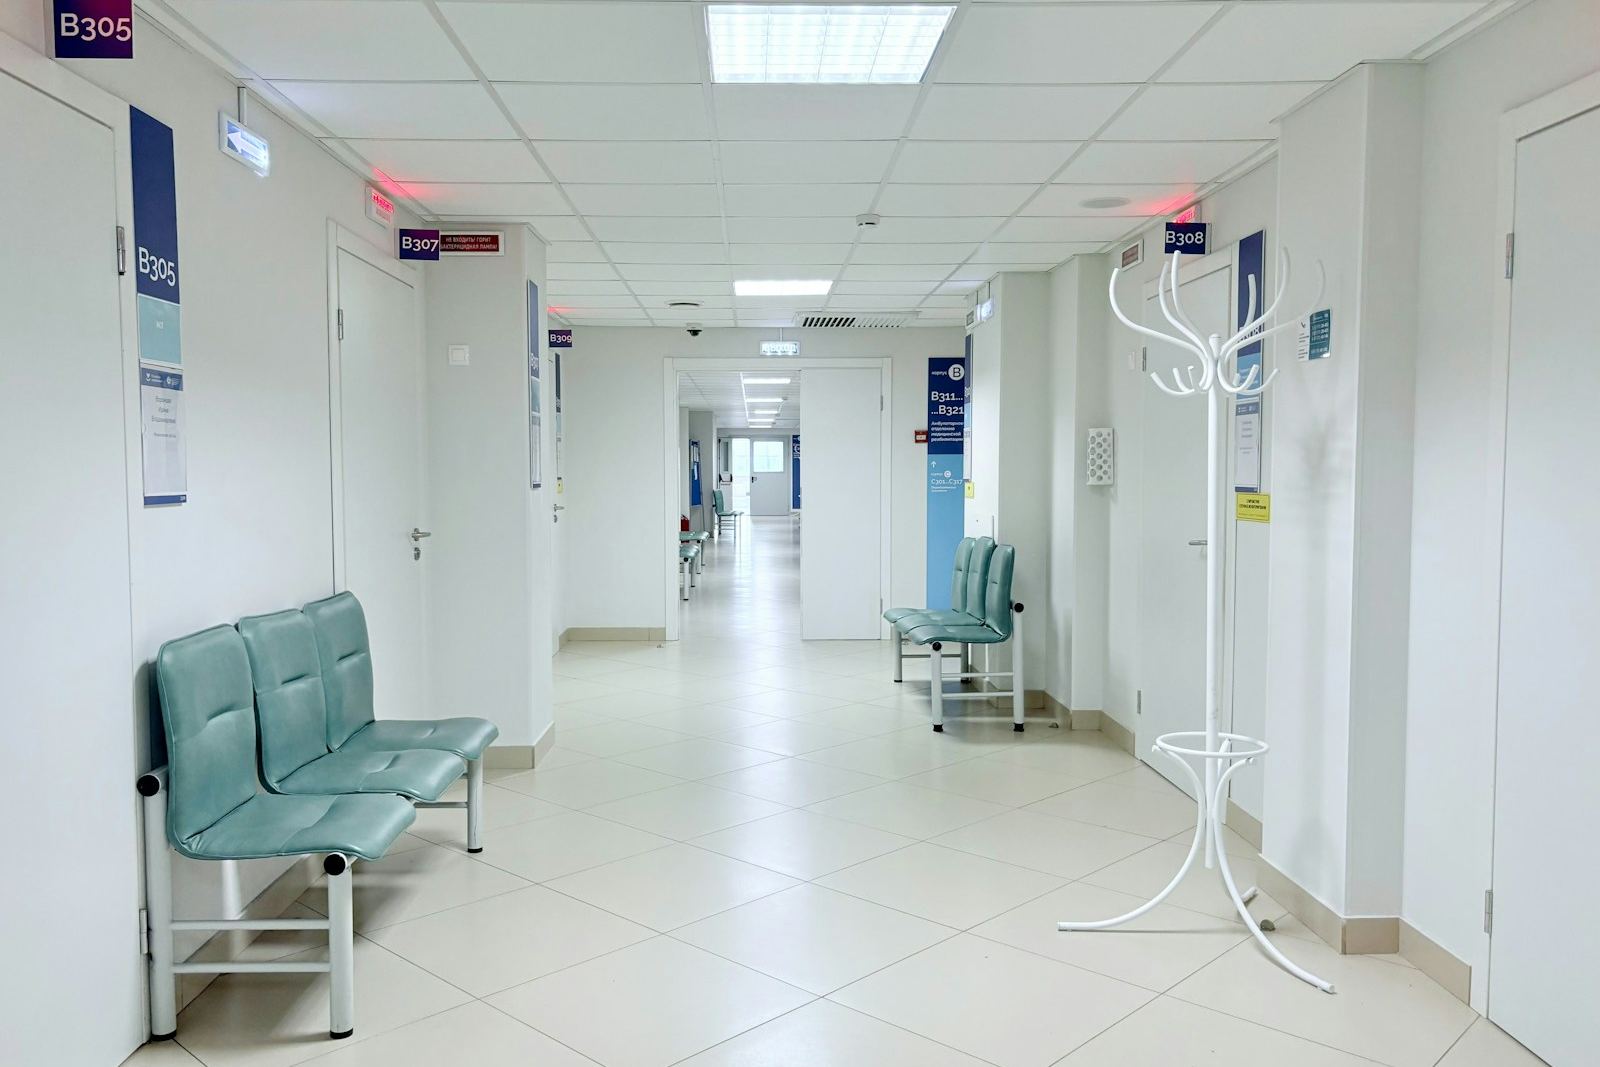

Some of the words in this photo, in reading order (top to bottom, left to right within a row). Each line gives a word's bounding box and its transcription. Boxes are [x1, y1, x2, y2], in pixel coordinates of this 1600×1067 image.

[60, 12, 132, 42] B305
[402, 236, 439, 252] B307
[1165, 230, 1204, 246] B308
[138, 246, 176, 287] B305
